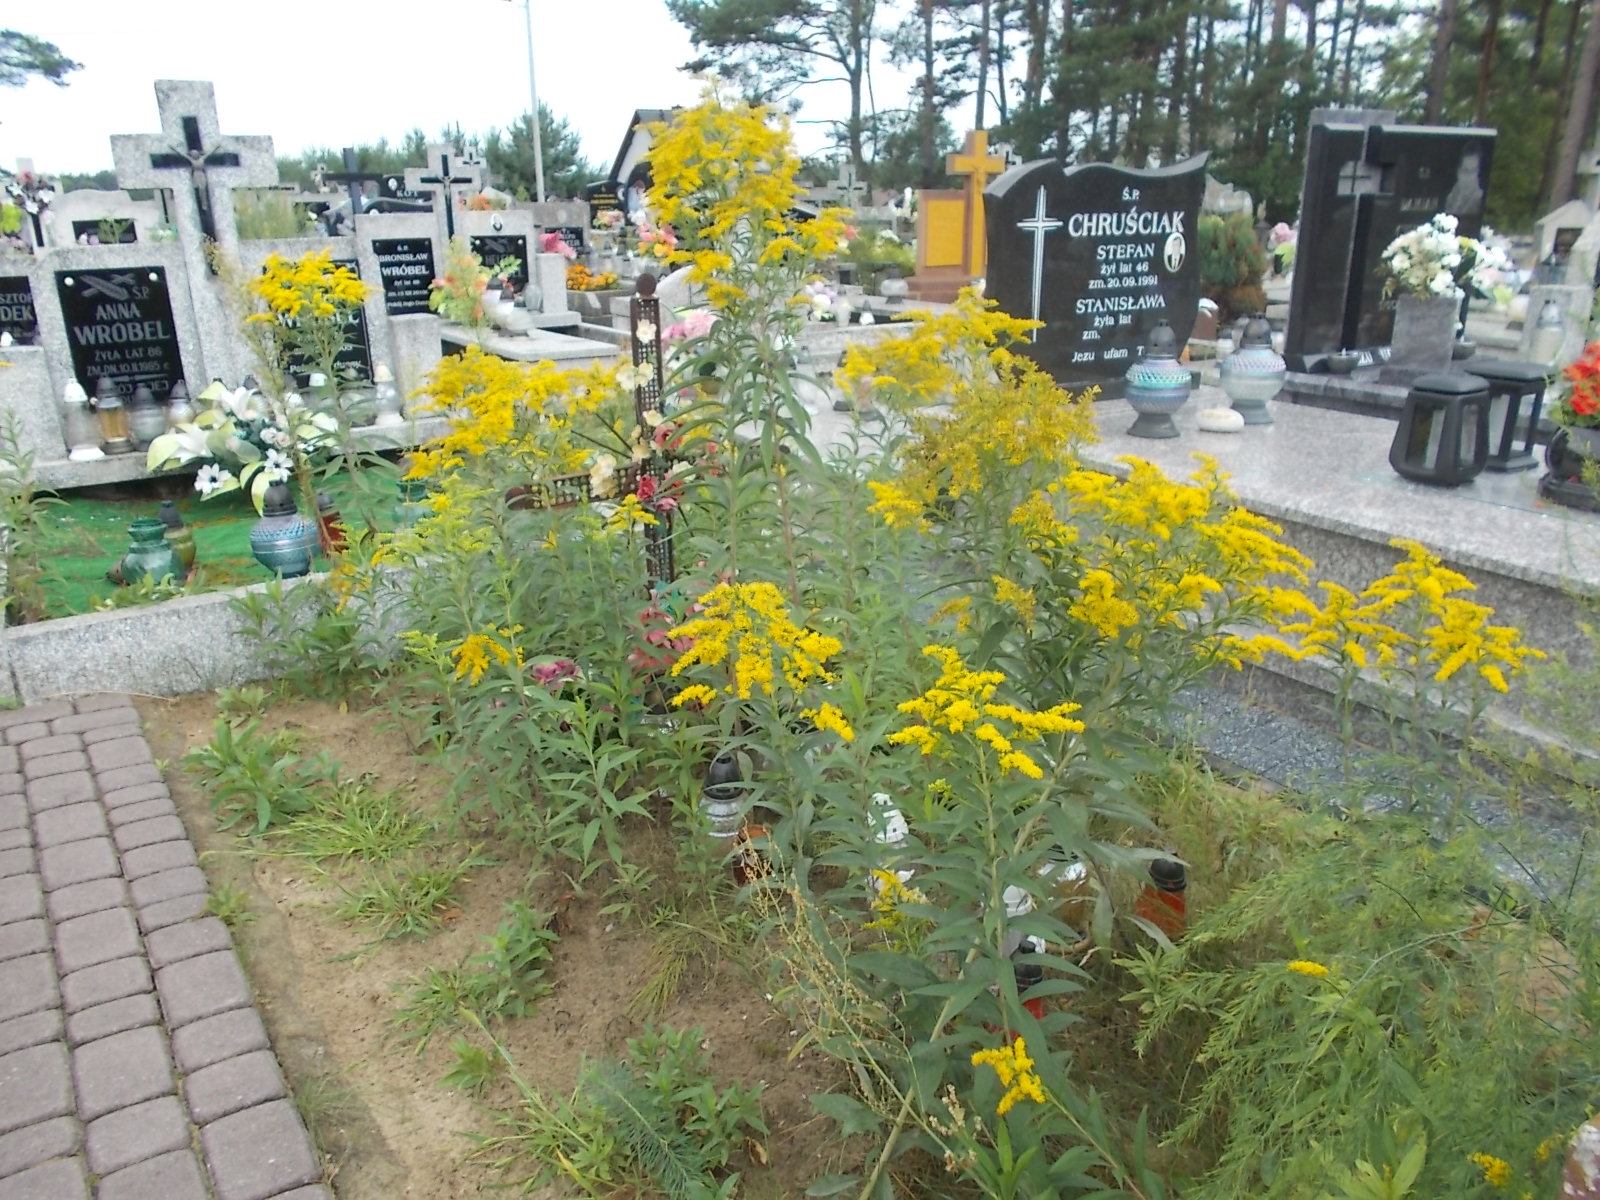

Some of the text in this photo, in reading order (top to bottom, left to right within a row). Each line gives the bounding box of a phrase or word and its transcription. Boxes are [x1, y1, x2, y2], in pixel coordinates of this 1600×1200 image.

[1068, 205, 1185, 237] CHRUŚCIAK
[379, 253, 428, 262] BRONISŁAW
[1096, 243, 1155, 260] STEFAN
[382, 263, 430, 276] WRÓBEL
[1100, 262, 1149, 276] żył lat 46
[1075, 294, 1166, 314] STANISŁAWA
[95, 303, 142, 321] ANNA
[1093, 314, 1132, 328] żyła lat
[73, 322, 170, 346] WRÓBEL
[1082, 330, 1101, 340] zm.
[94, 349, 121, 362] ŻYŁA
[124, 347, 143, 359] LAT
[1072, 350, 1095, 363] Jezu
[1104, 347, 1128, 359] ufam
